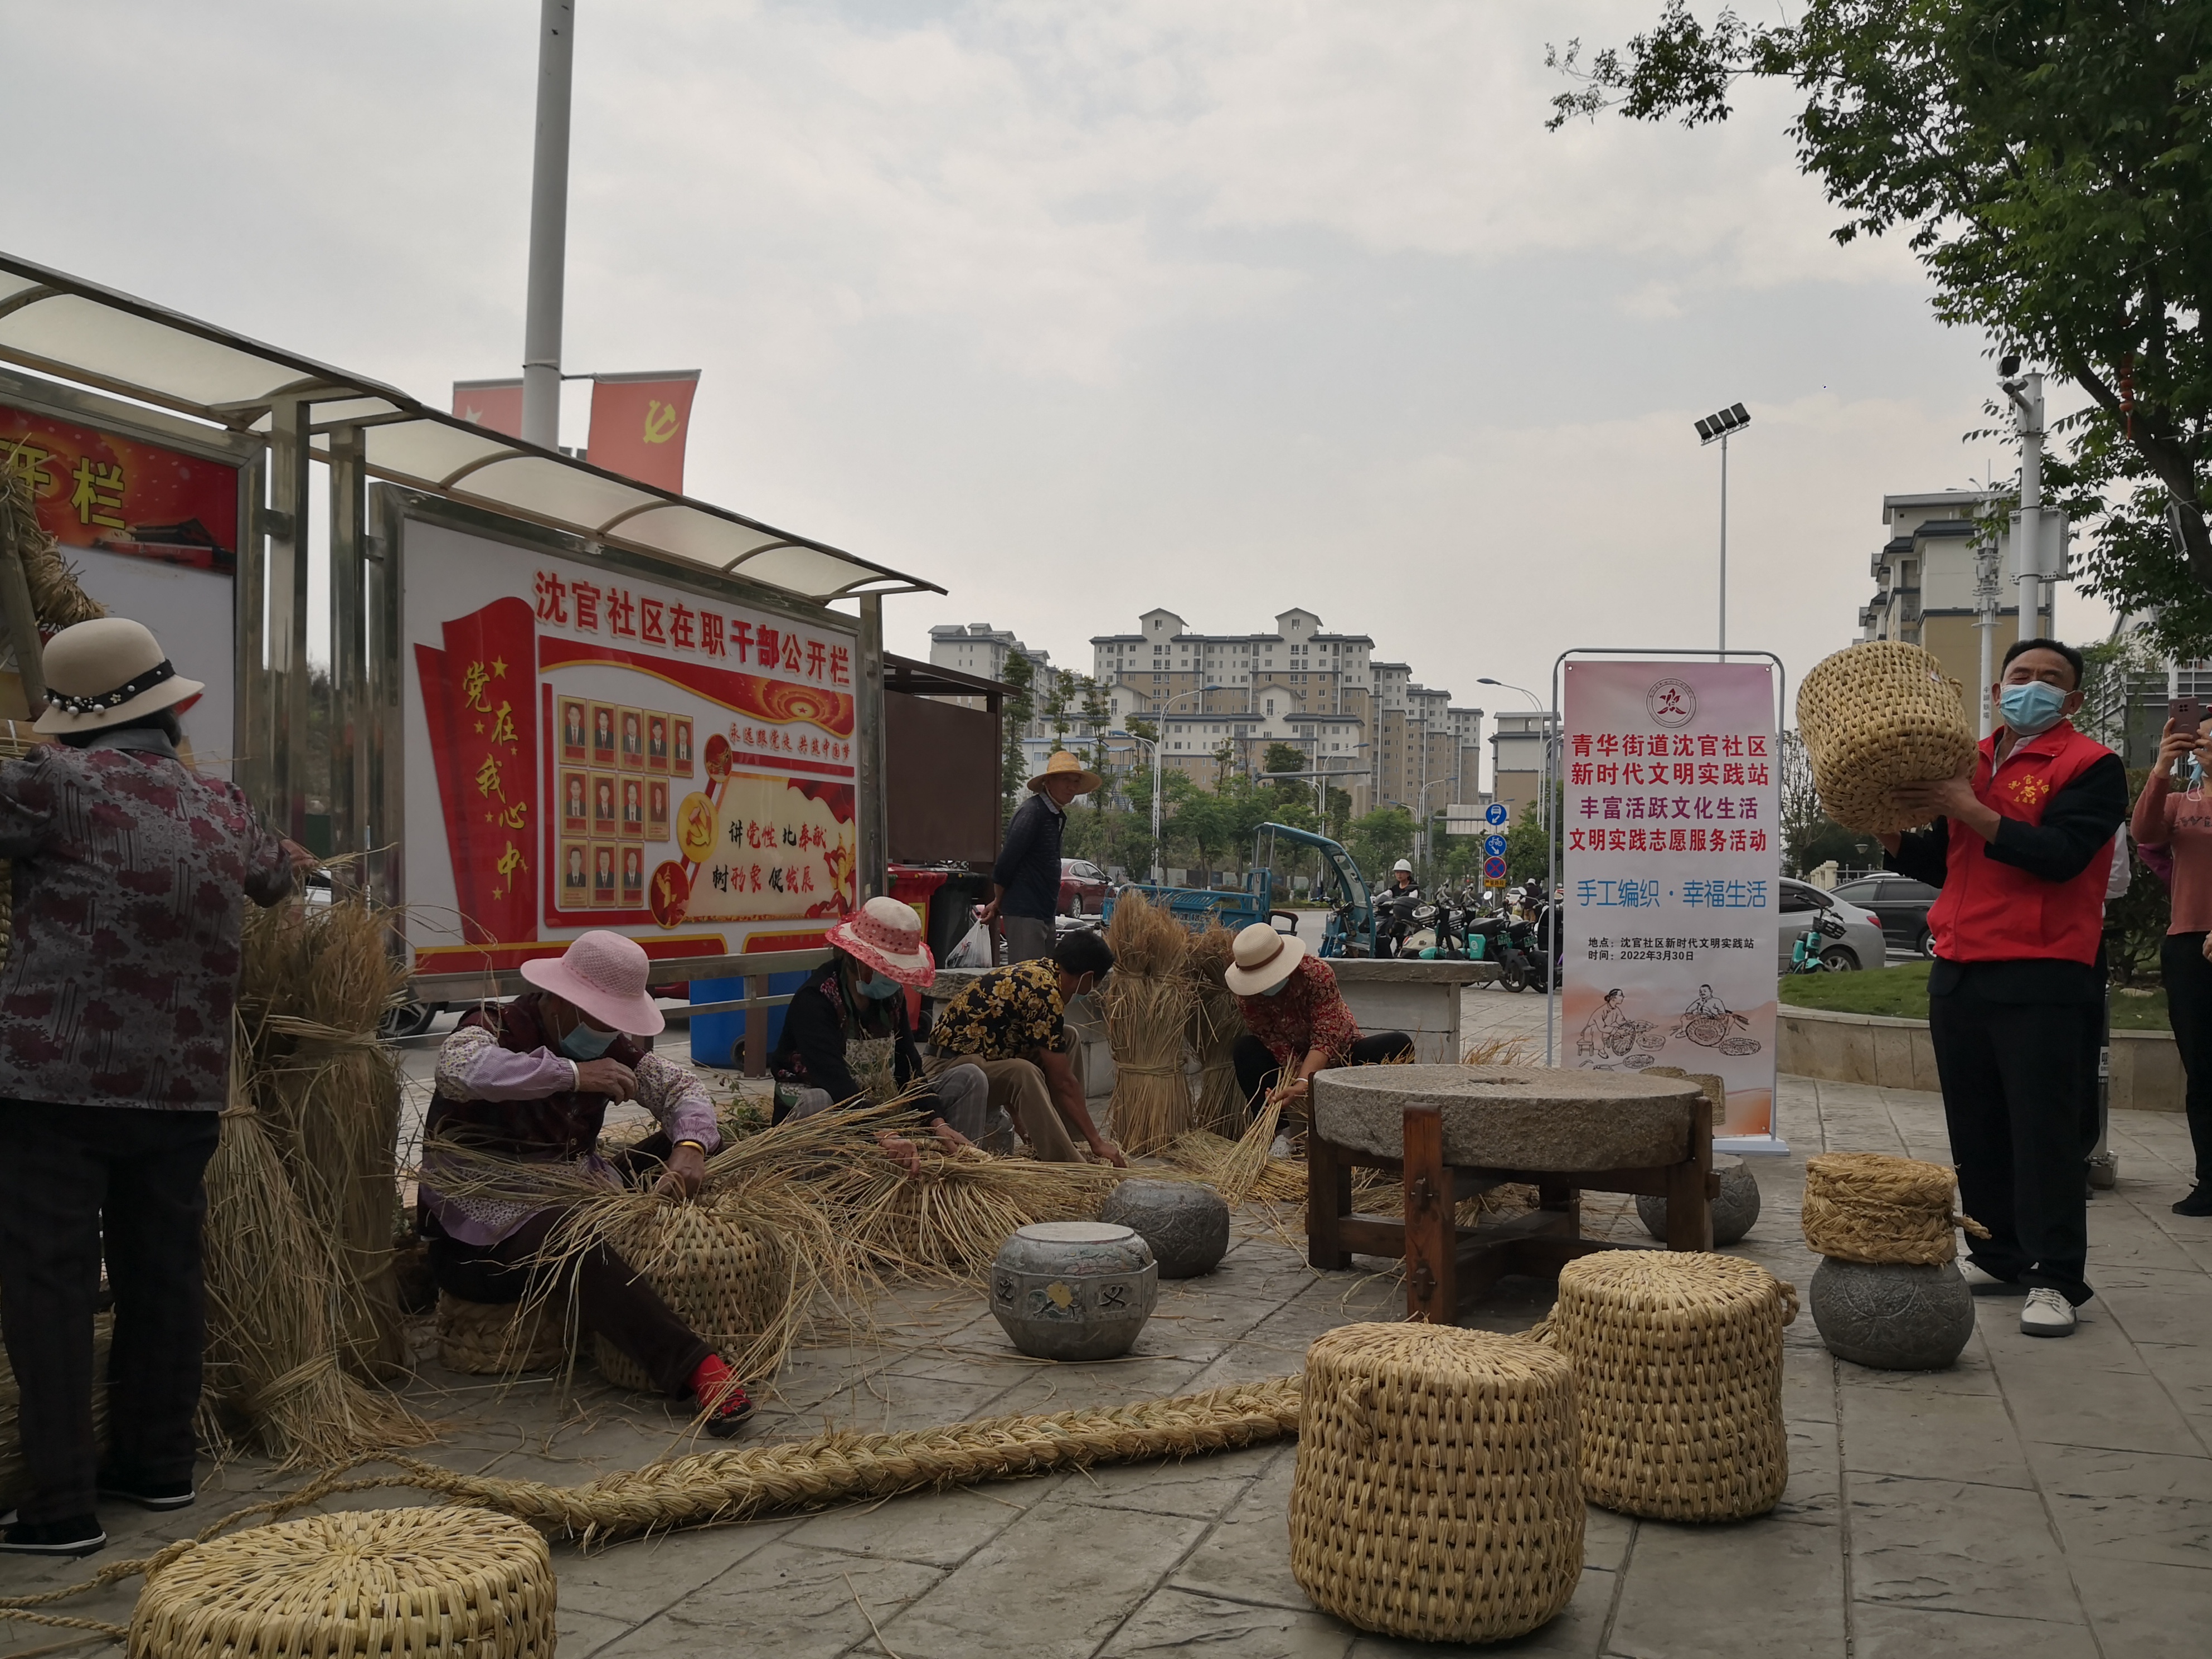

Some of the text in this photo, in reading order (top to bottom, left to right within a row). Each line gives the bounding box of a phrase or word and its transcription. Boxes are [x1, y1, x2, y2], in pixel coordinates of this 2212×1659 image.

[535, 570, 850, 685] 沈官社区在职干部公开栏
[798, 735, 851, 761] 共筑中国梦
[1571, 734, 1768, 758] 青华街道沈官社区
[463, 660, 528, 893] 党在我心中
[1571, 761, 1769, 786] 新时代文明实践站
[1580, 796, 1758, 819] 丰富活跃文化生活
[728, 820, 827, 851] 讲党性 比奉献
[1569, 828, 1767, 852] 文明实践志愿服务活动
[713, 863, 814, 894] 树形象 促发展
[1576, 879, 1767, 909] 手工编织·幸福生活
[1588, 949, 1694, 961] 时间：2022年3月30日
